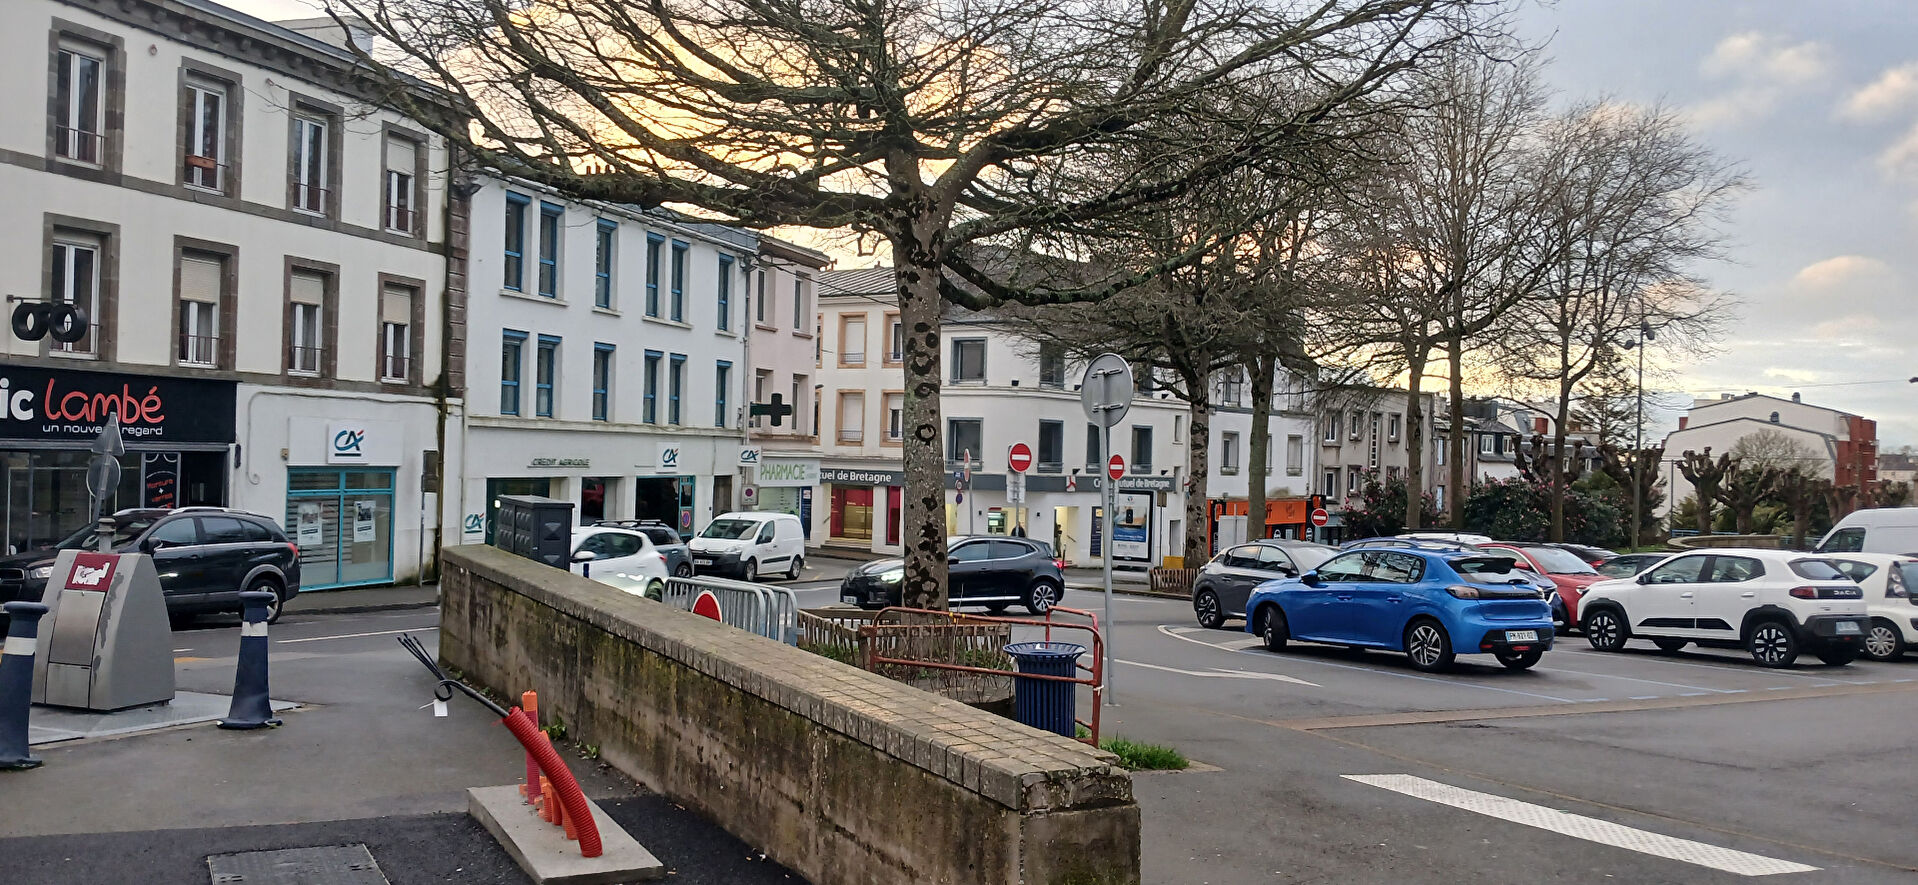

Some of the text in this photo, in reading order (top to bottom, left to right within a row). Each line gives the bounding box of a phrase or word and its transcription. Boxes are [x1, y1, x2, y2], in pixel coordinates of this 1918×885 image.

[42, 424, 60, 433] un
[121, 426, 163, 437] regard
[760, 463, 806, 481] PHARMACIE
[837, 470, 849, 481] de
[849, 471, 892, 484] Bretagne
[1144, 478, 1170, 490] Bretagne
